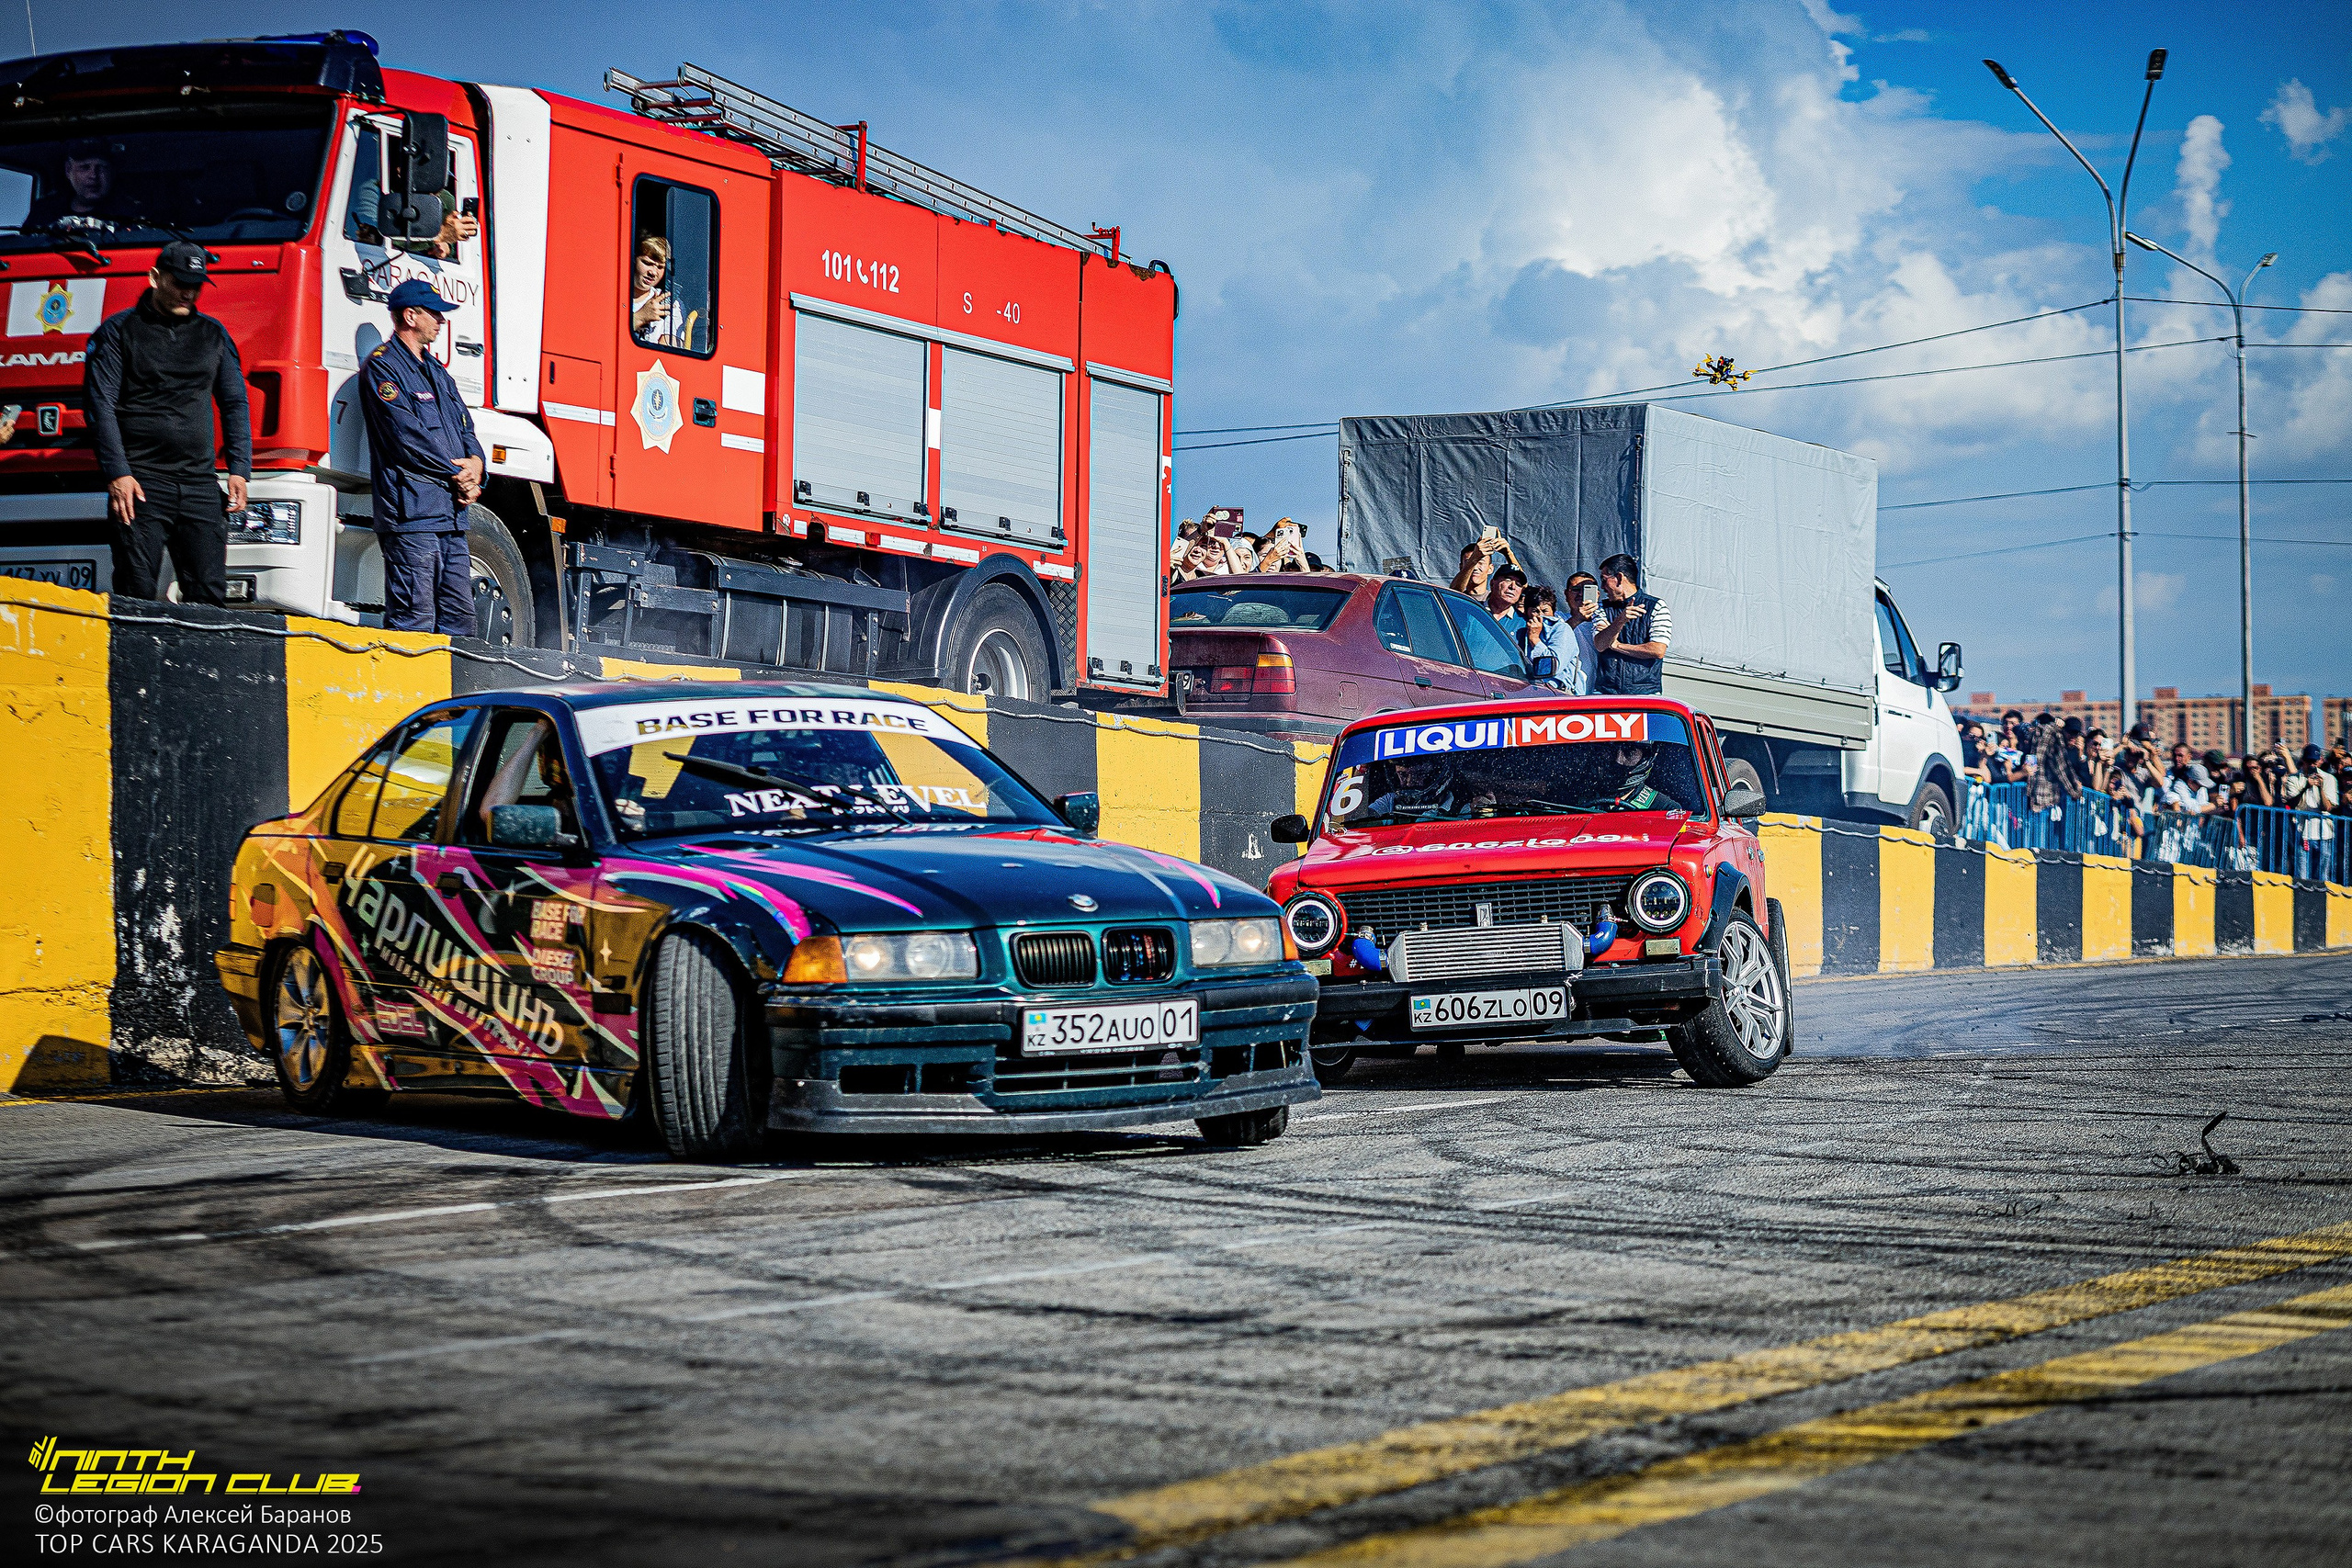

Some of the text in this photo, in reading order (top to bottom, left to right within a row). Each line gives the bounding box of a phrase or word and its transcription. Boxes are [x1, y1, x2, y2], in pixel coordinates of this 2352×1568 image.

[361, 258, 480, 307] QARANDY
[821, 249, 899, 293] 101 112
[963, 291, 973, 314] S
[0, 351, 87, 367] AMA
[70, 566, 92, 587] 09
[636, 709, 930, 736] BASE FOR RACE
[1384, 713, 1641, 757] LIQUI MOLY
[724, 784, 988, 817] NEXT LEVEL
[1330, 775, 1364, 817] 6
[1413, 991, 1563, 1023] KZ 606ZLO 09
[1027, 1006, 1193, 1047] KZ 352AUO 01
